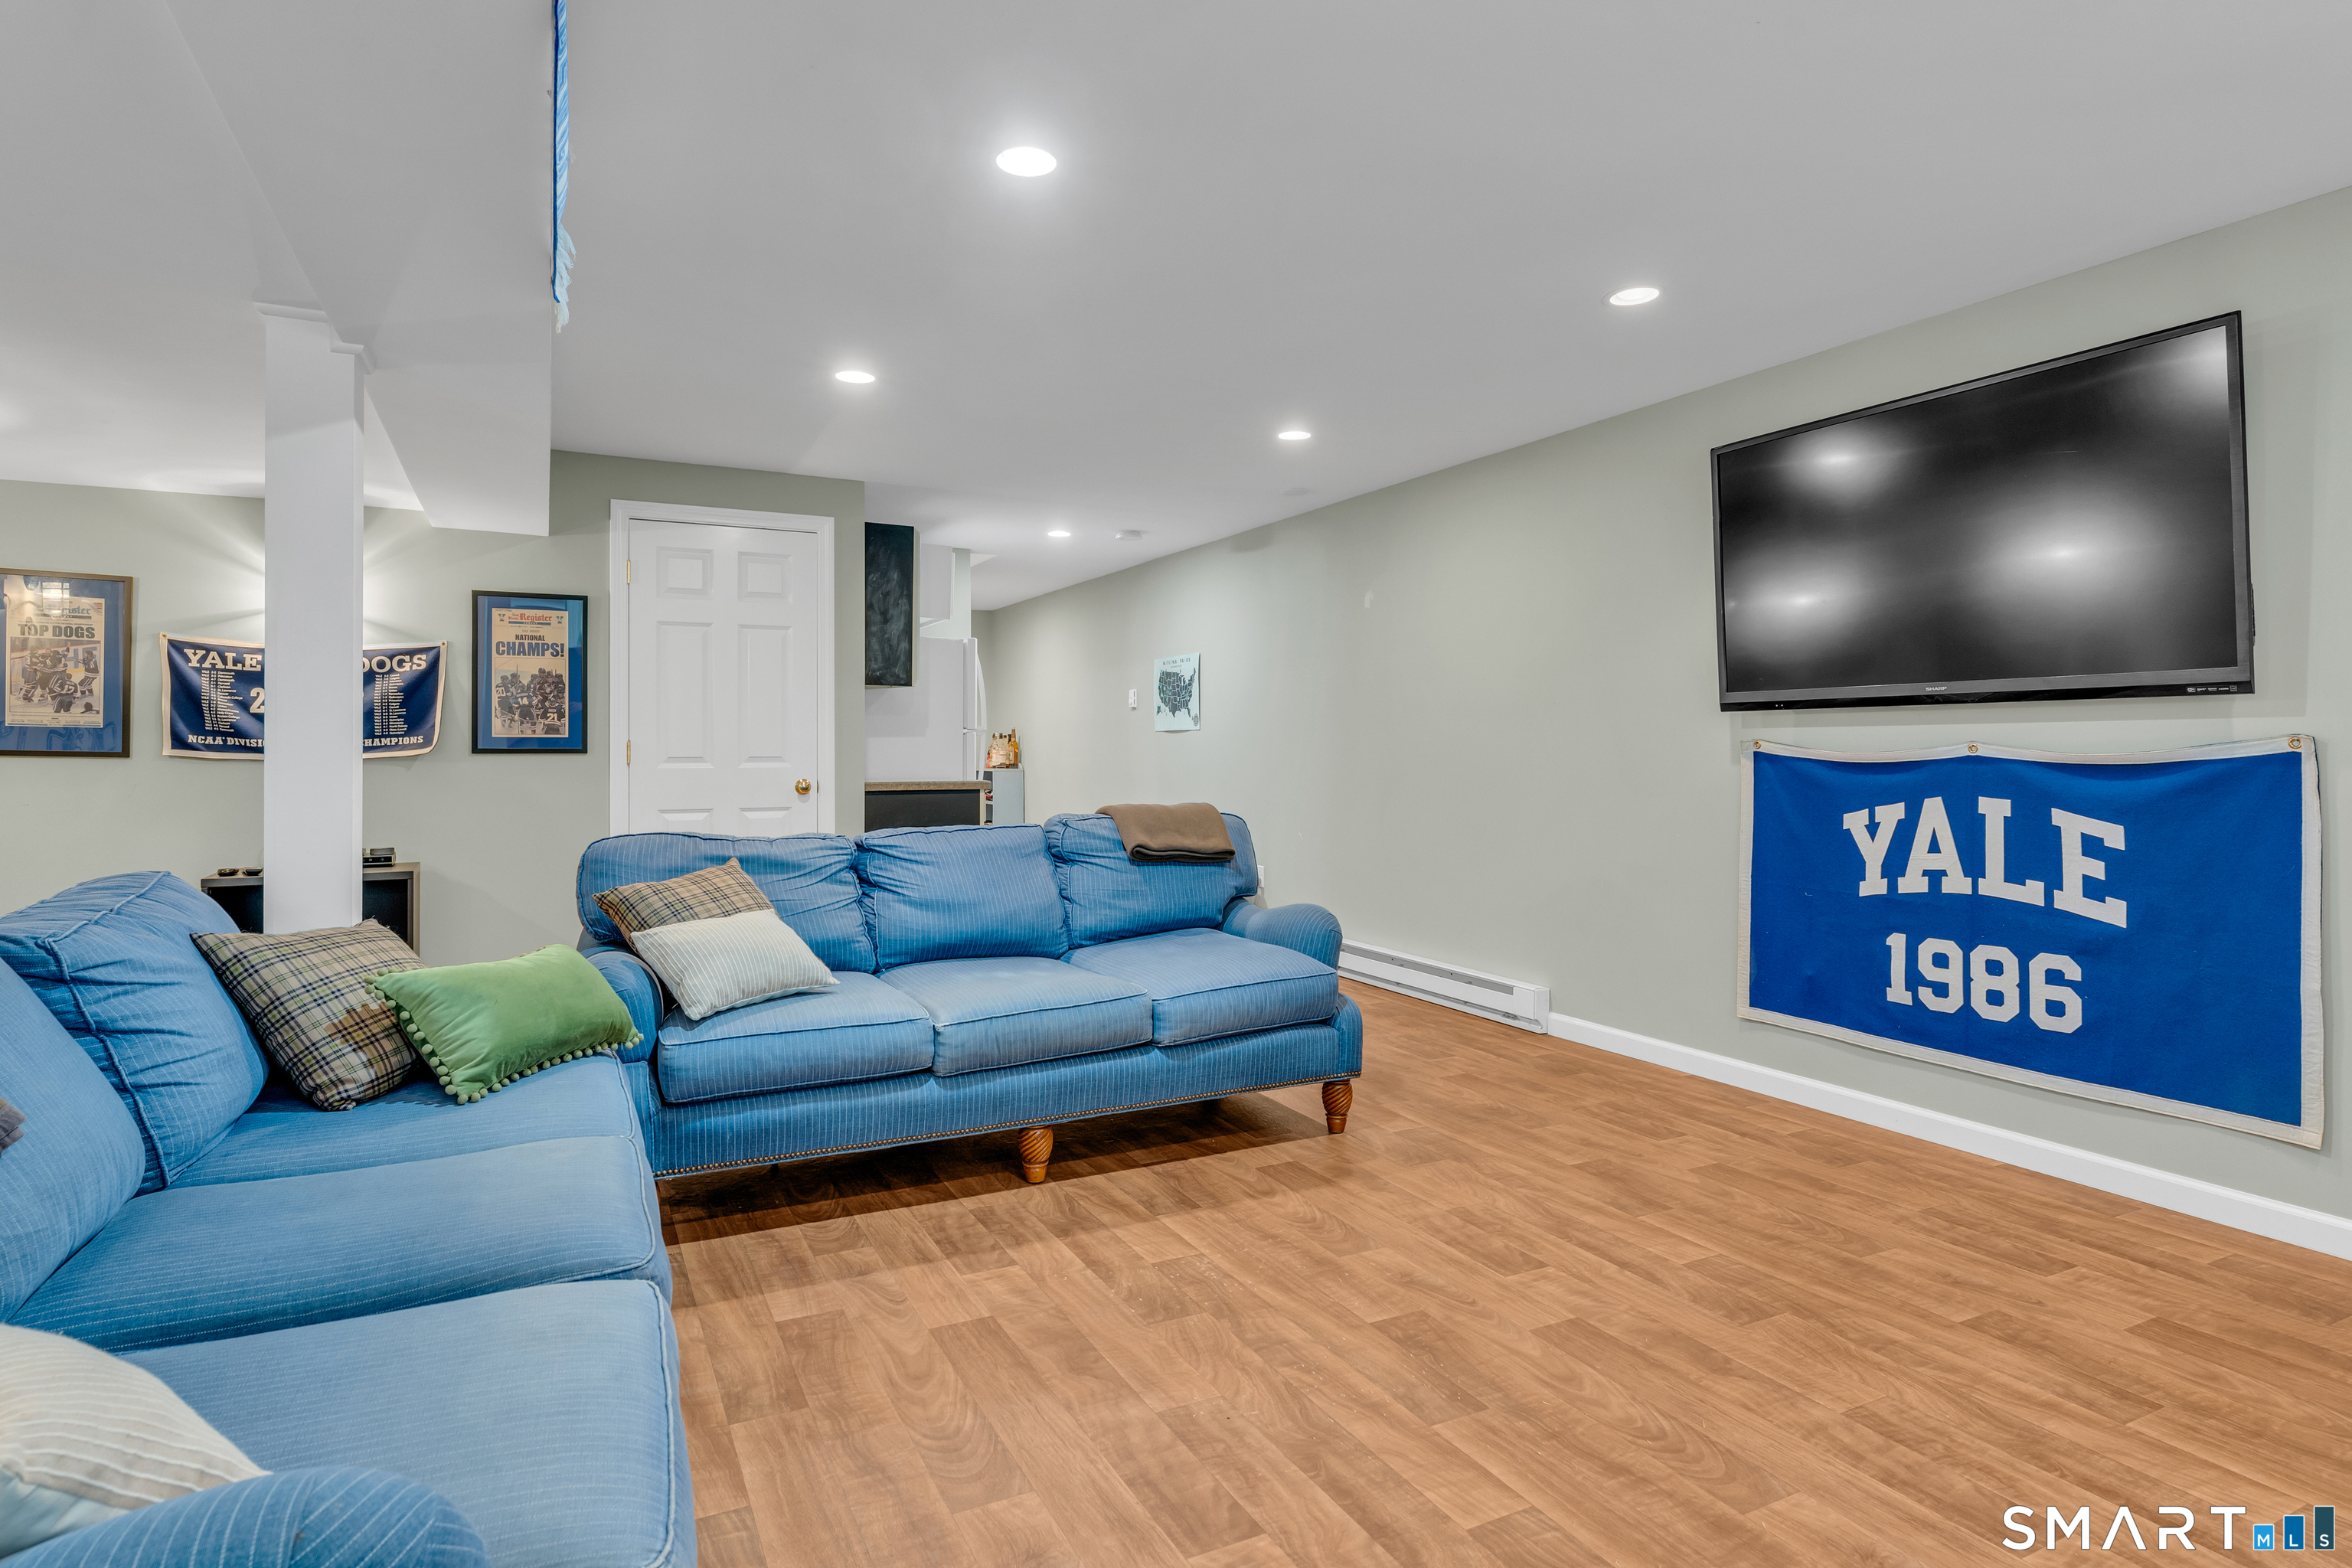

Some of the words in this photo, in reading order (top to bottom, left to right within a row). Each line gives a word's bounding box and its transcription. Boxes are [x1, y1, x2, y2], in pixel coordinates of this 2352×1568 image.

[519, 613, 552, 622] Register
[18, 623, 49, 637] TOP
[52, 625, 96, 639] DOGS
[495, 641, 565, 658] CHAMPS!
[184, 648, 263, 671] YALE
[227, 738, 265, 747] DIVISI
[363, 736, 423, 746] HAMPIONS
[1843, 796, 2127, 929] YALE
[1886, 933, 2082, 1034] 1986
